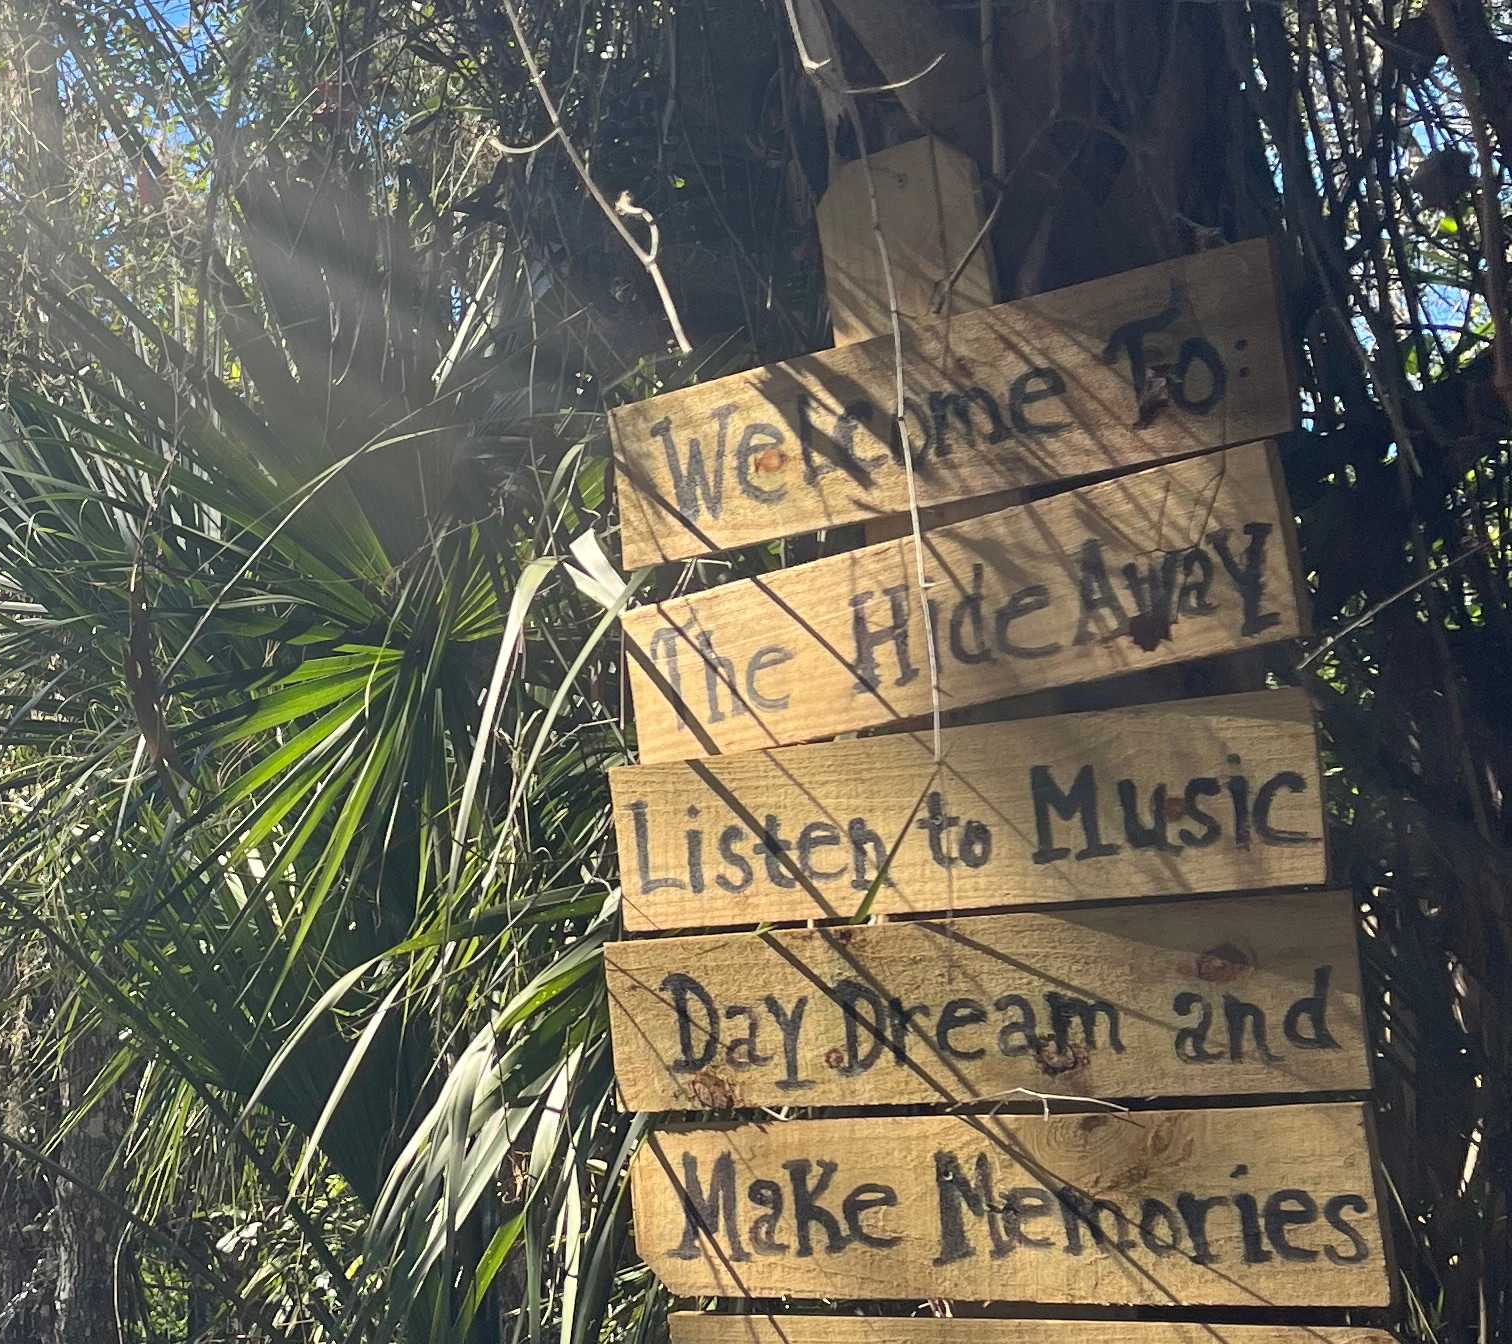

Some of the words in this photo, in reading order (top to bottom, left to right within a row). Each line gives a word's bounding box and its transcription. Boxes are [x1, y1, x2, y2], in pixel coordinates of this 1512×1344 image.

[651, 611, 792, 732] The
[625, 798, 890, 897] Listen
[917, 790, 993, 870] to
[1031, 752, 1316, 867] Music
[1173, 963, 1343, 1065] and
[931, 1149, 1371, 1268] Memories
